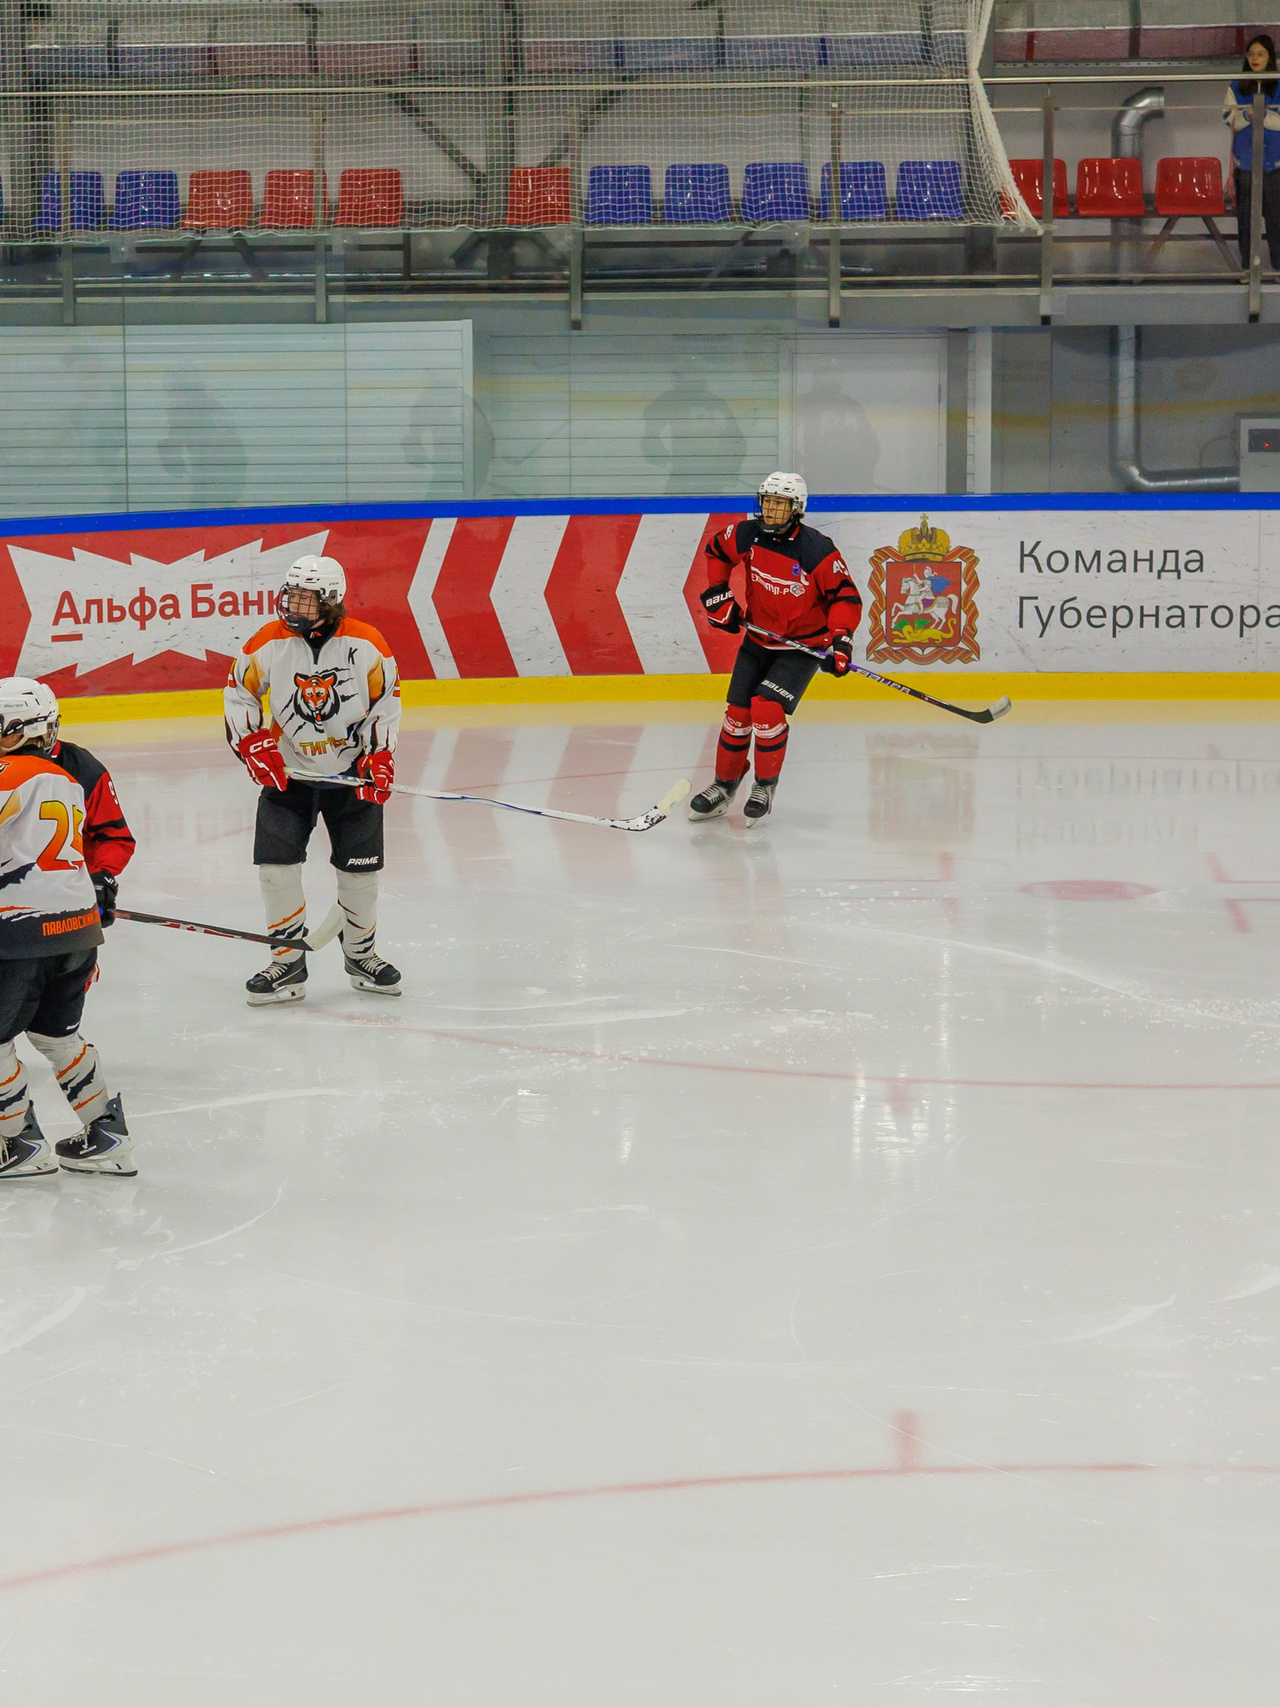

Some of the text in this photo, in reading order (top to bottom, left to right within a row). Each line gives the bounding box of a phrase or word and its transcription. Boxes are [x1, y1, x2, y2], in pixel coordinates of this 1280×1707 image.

[1018, 540, 1204, 580] Команда
[52, 585, 181, 631] Альфа
[1018, 596, 1280, 638] Губернатора
[761, 679, 795, 702] BAUER
[346, 856, 379, 867] PRIME
